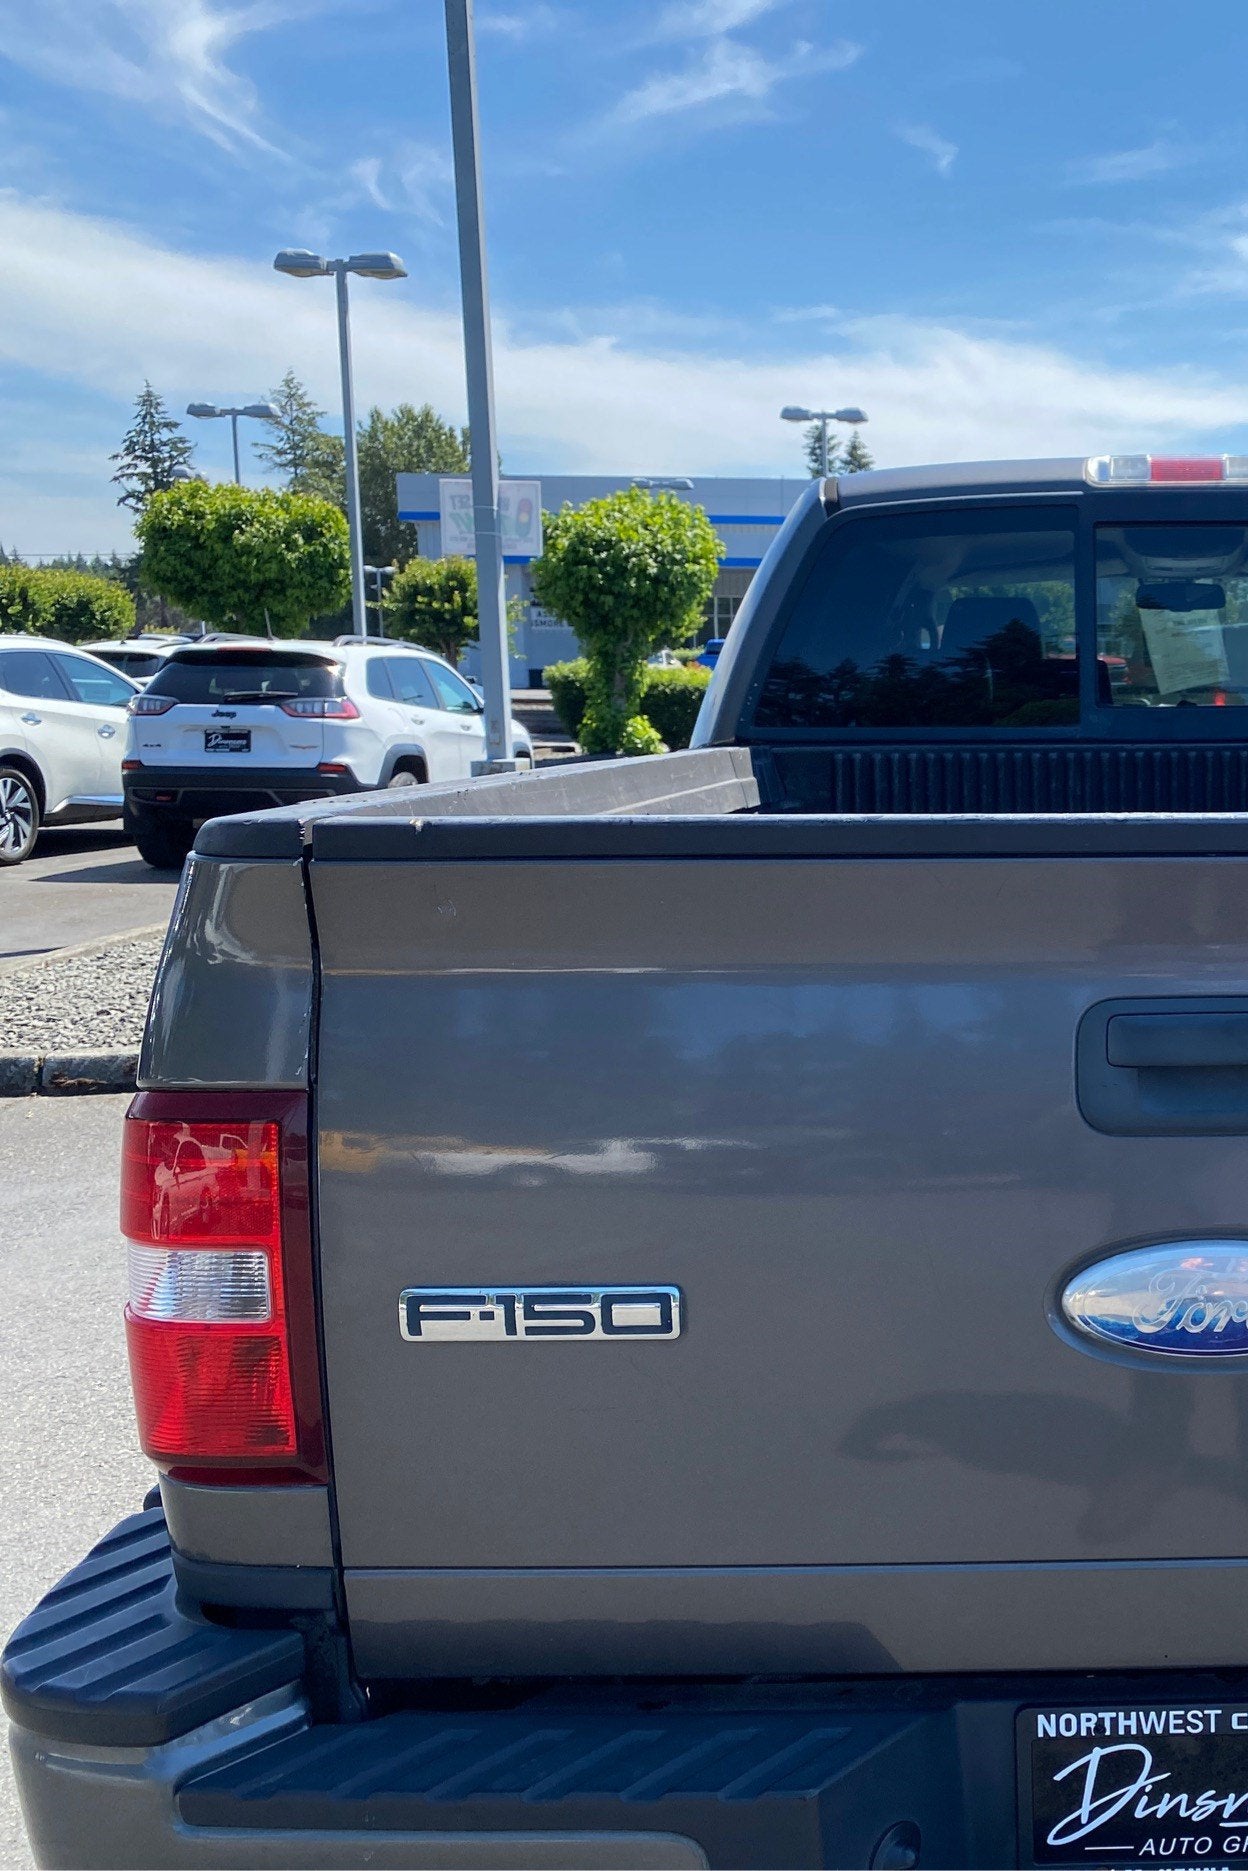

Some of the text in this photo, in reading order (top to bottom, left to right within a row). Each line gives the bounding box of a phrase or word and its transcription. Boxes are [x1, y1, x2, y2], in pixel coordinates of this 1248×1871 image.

[211, 710, 237, 719] Jeep
[406, 1293, 673, 1336] F-150
[1037, 1709, 1222, 1738] NORTHWEST
[1138, 1838, 1212, 1857] AUTO
